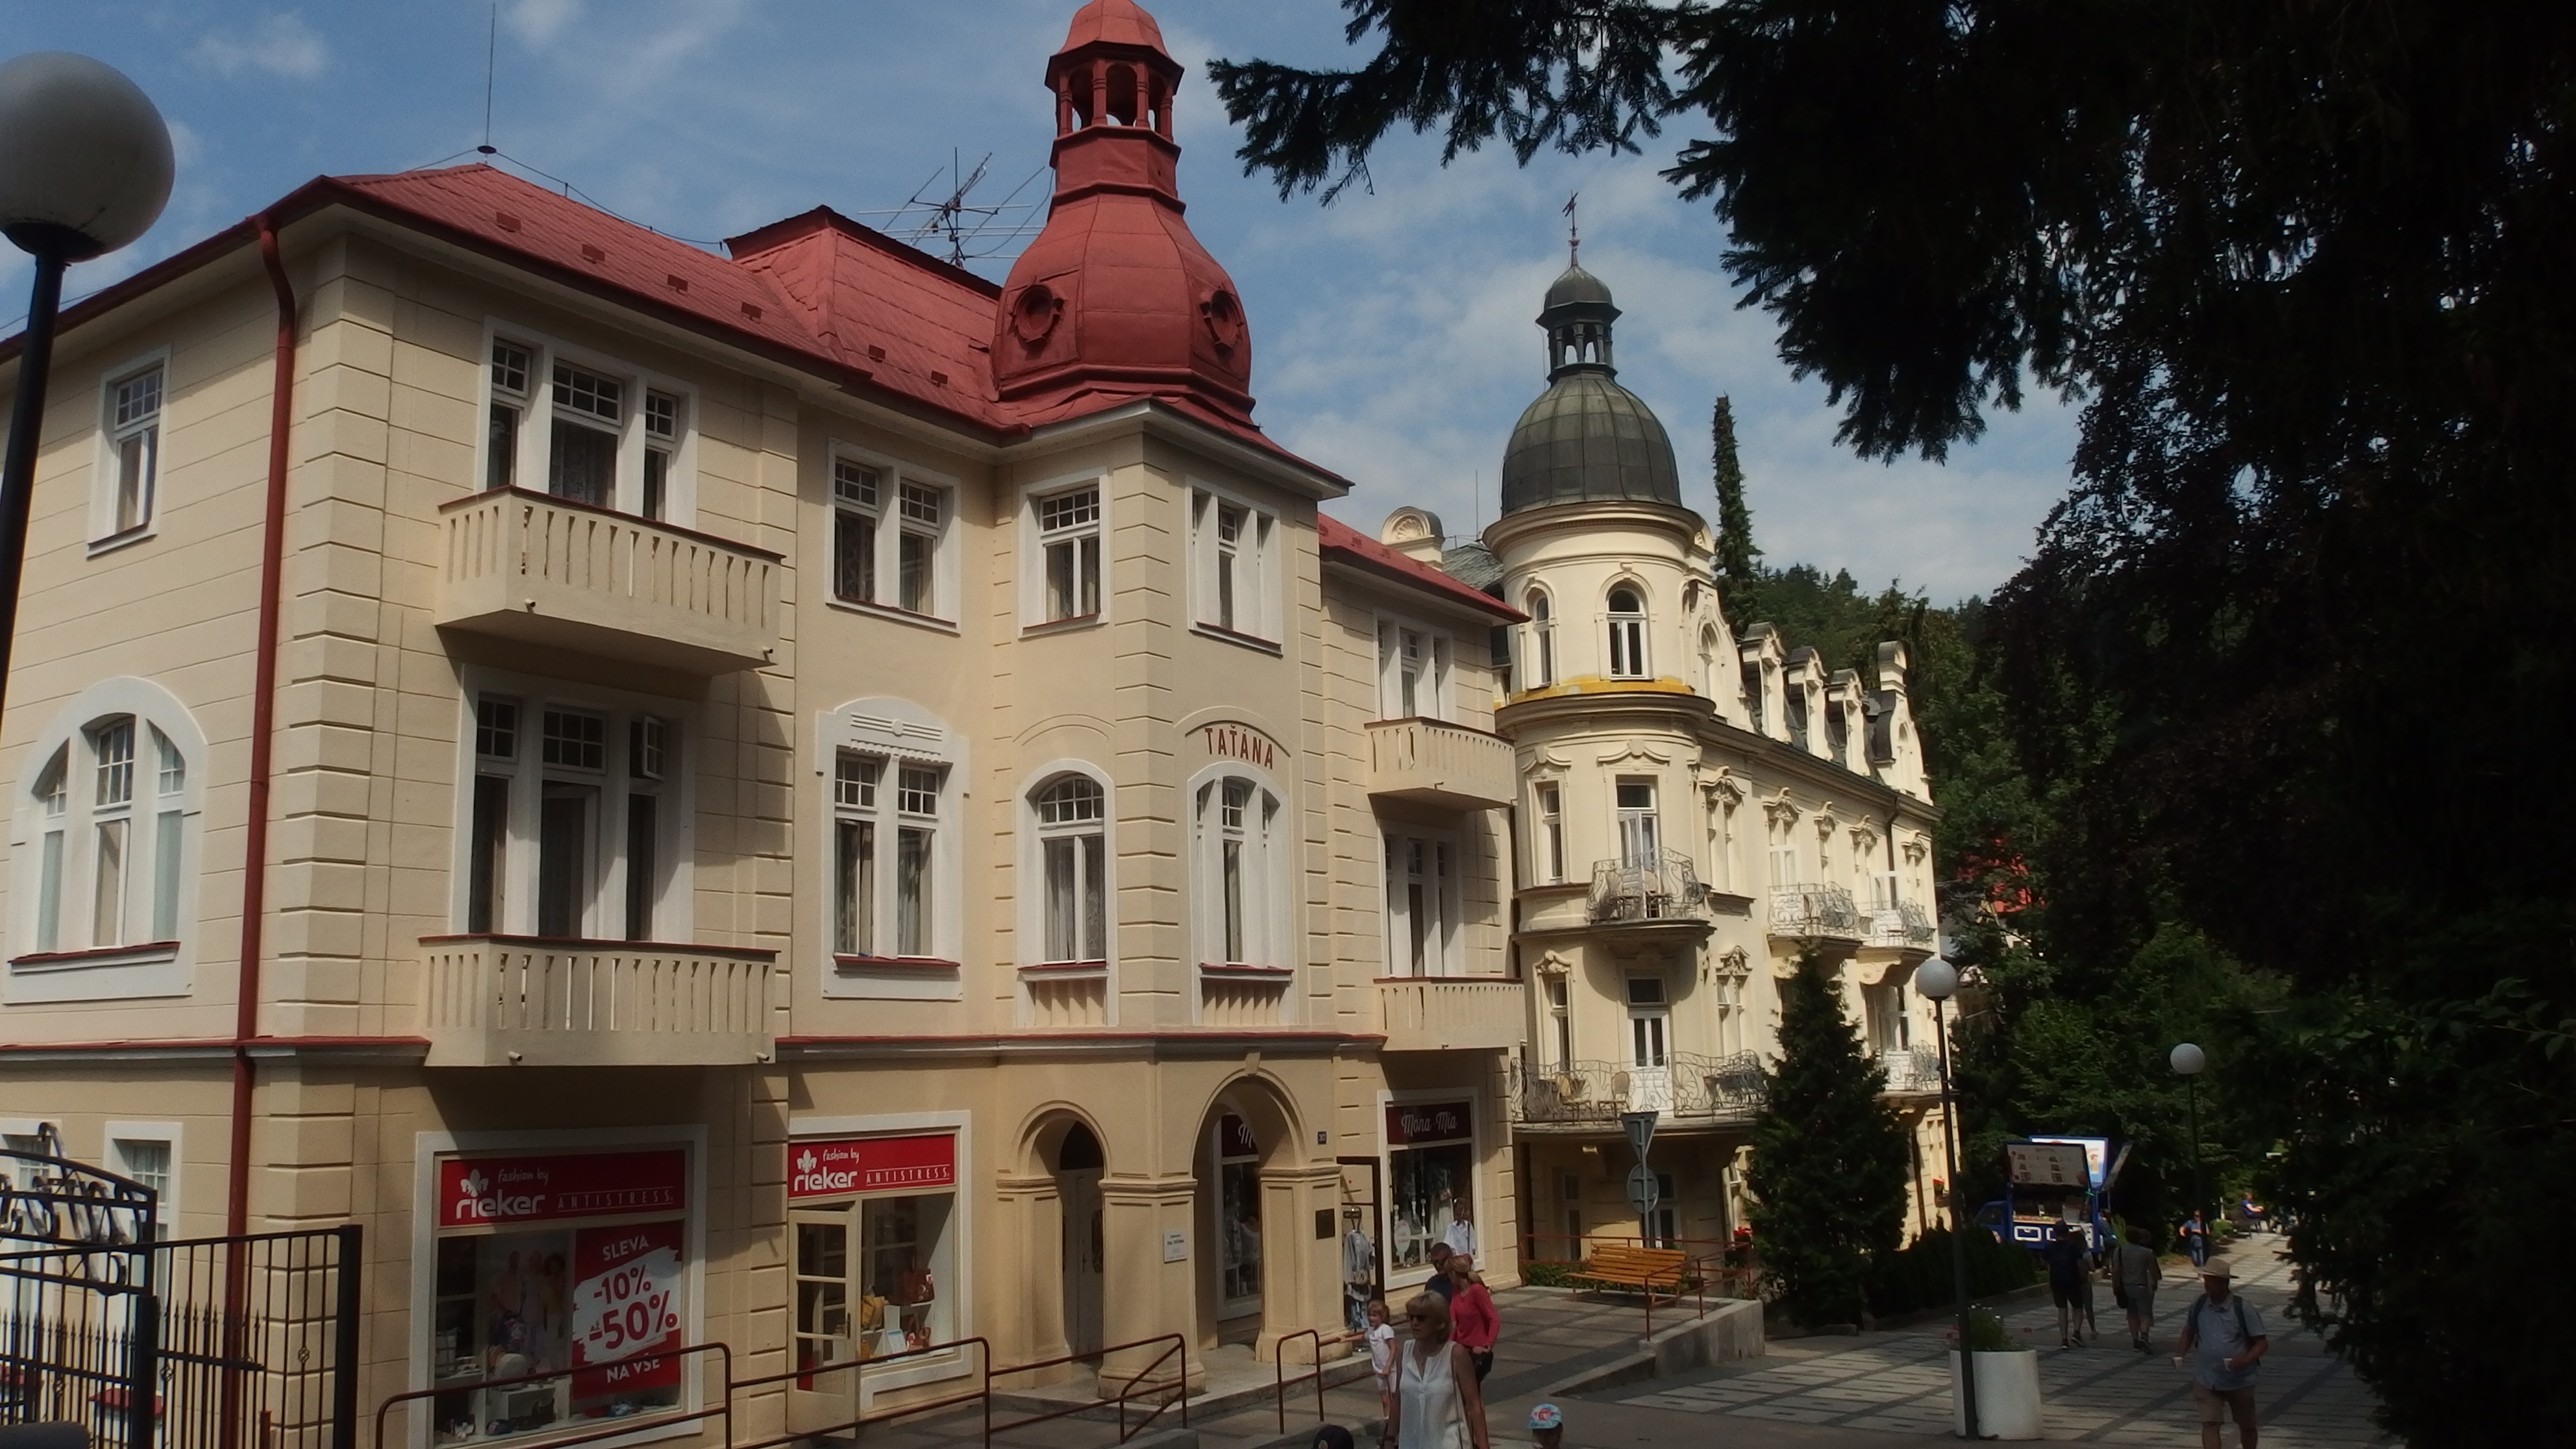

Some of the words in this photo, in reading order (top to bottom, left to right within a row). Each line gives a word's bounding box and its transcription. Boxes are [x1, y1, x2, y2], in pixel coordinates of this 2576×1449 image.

[1205, 724, 1273, 771] TAŤÁNA
[1401, 1114, 1431, 1137] Mona
[1435, 1111, 1457, 1134] Mia
[823, 1148, 848, 1162] fashion
[850, 1147, 860, 1164] by
[498, 1169, 534, 1183] fashion
[537, 1167, 549, 1185] by
[794, 1166, 858, 1192] rieker
[866, 1167, 947, 1184] ANTISTRESS
[456, 1189, 545, 1219] rieker
[558, 1189, 670, 1209] ANTISTRESS
[602, 1235, 649, 1261] SLEVA
[594, 1265, 651, 1305] -10%
[589, 1290, 677, 1349] -50%
[606, 1366, 630, 1383] NA
